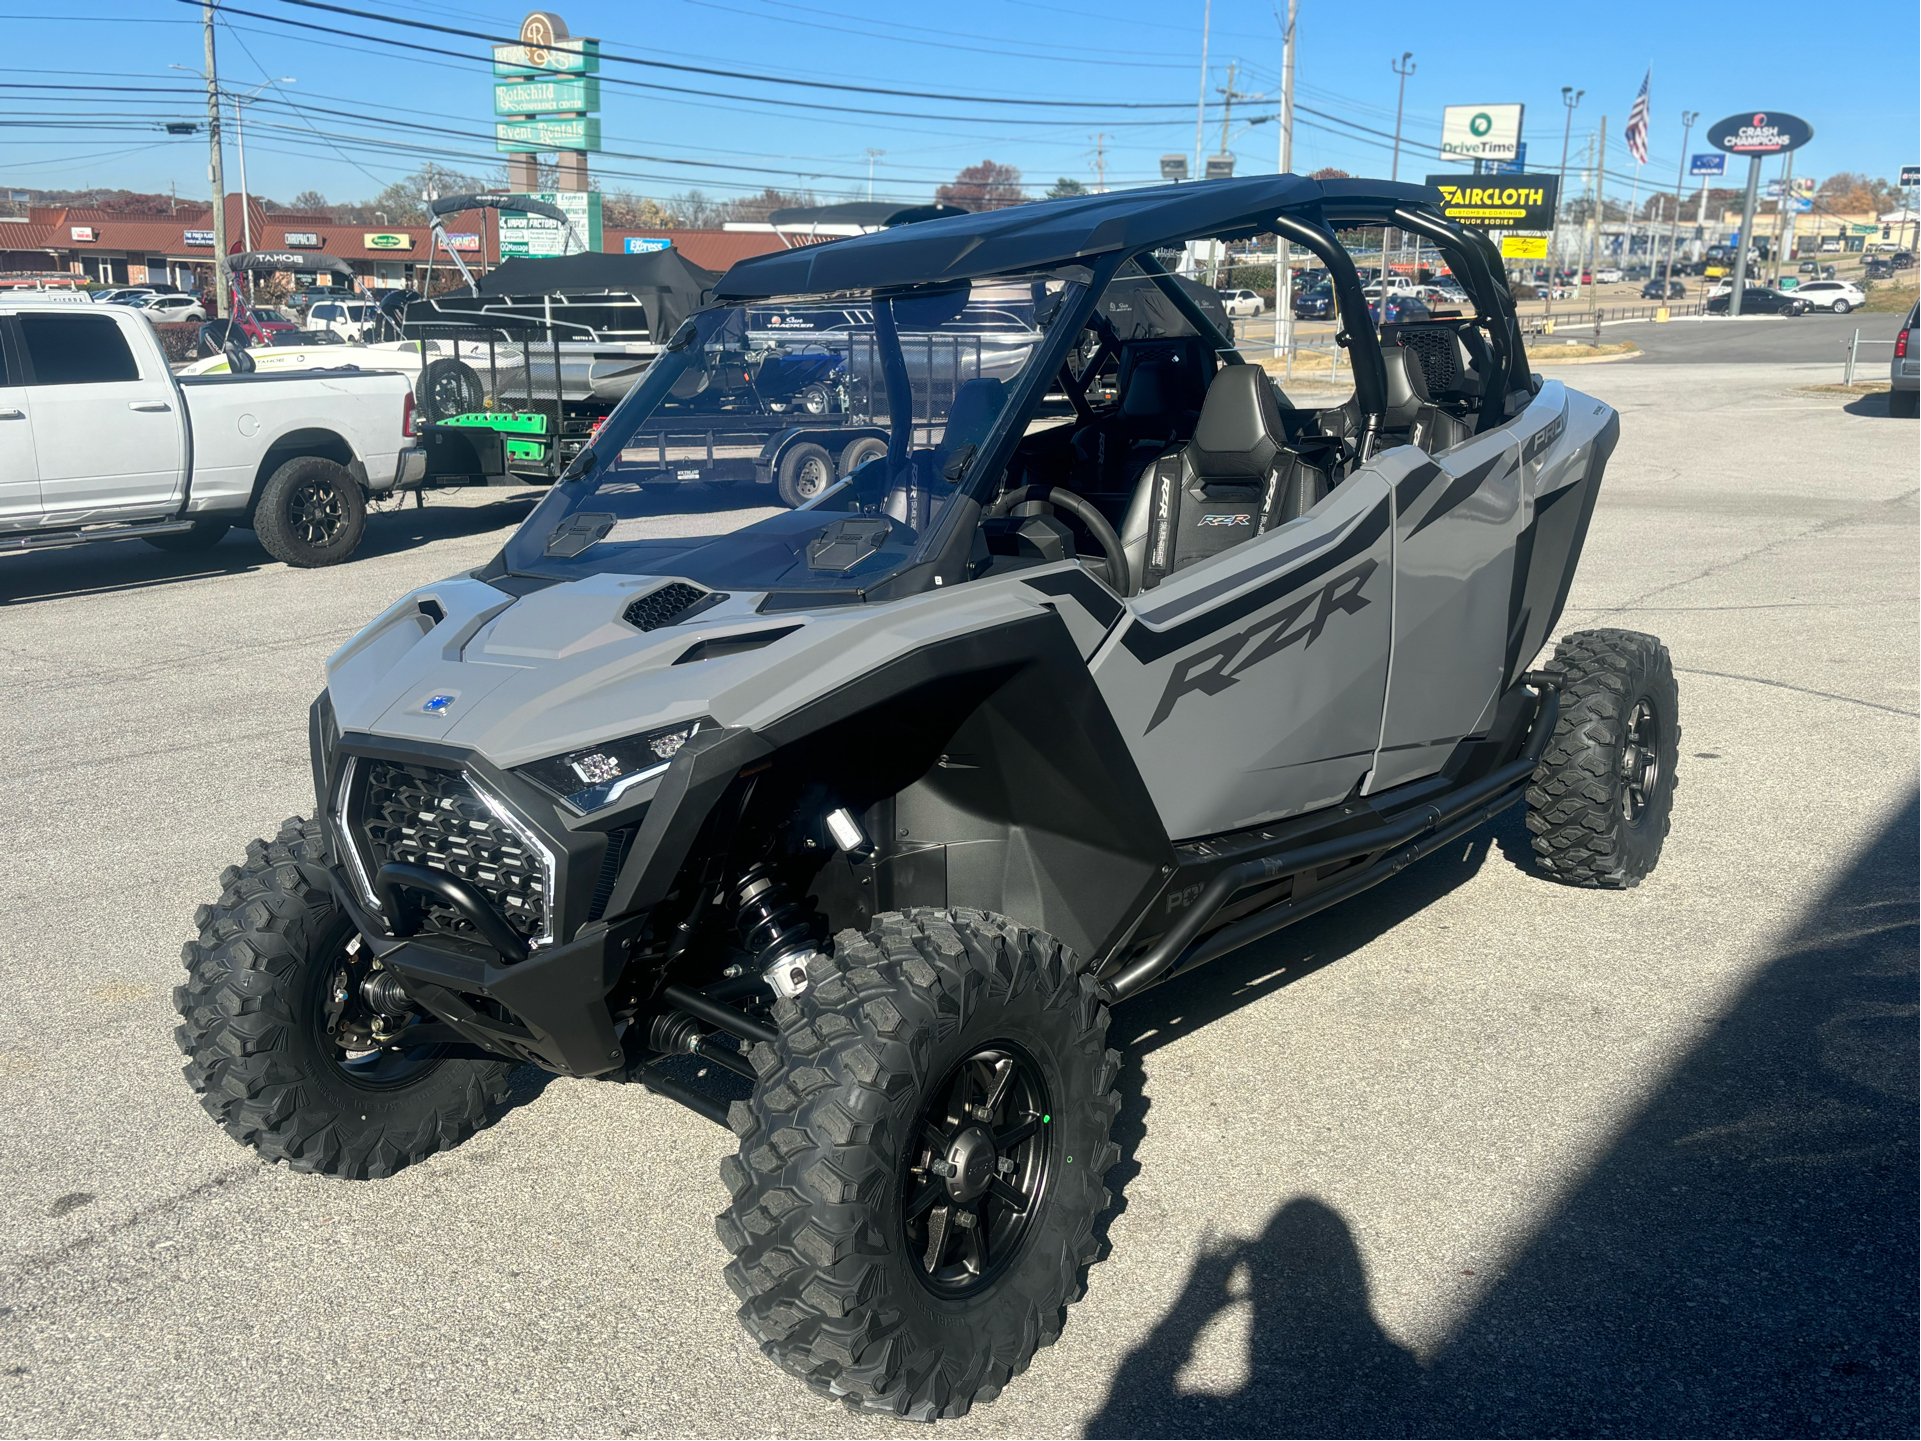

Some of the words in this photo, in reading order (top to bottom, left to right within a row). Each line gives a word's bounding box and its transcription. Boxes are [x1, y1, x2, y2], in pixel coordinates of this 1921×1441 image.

[496, 83, 554, 106] Rothchild
[519, 101, 557, 111] CONFERENCE
[559, 100, 582, 108] CENTER
[497, 124, 532, 138] Event
[538, 122, 583, 140] Rentals
[1738, 127, 1778, 136] CRASH
[1443, 141, 1515, 153] DriveTime
[1724, 135, 1790, 146] CHAMPIONS
[1437, 186, 1544, 207] FAIRCLOTH
[285, 233, 317, 245] CHIROPRACTOR
[256, 254, 304, 263] TAHOE
[1533, 418, 1563, 452] PRO
[910, 462, 918, 498] RZR
[1159, 476, 1171, 519] RZR
[1263, 468, 1278, 512] RZR
[1197, 514, 1251, 526] RZR
[1143, 557, 1379, 737] RZR
